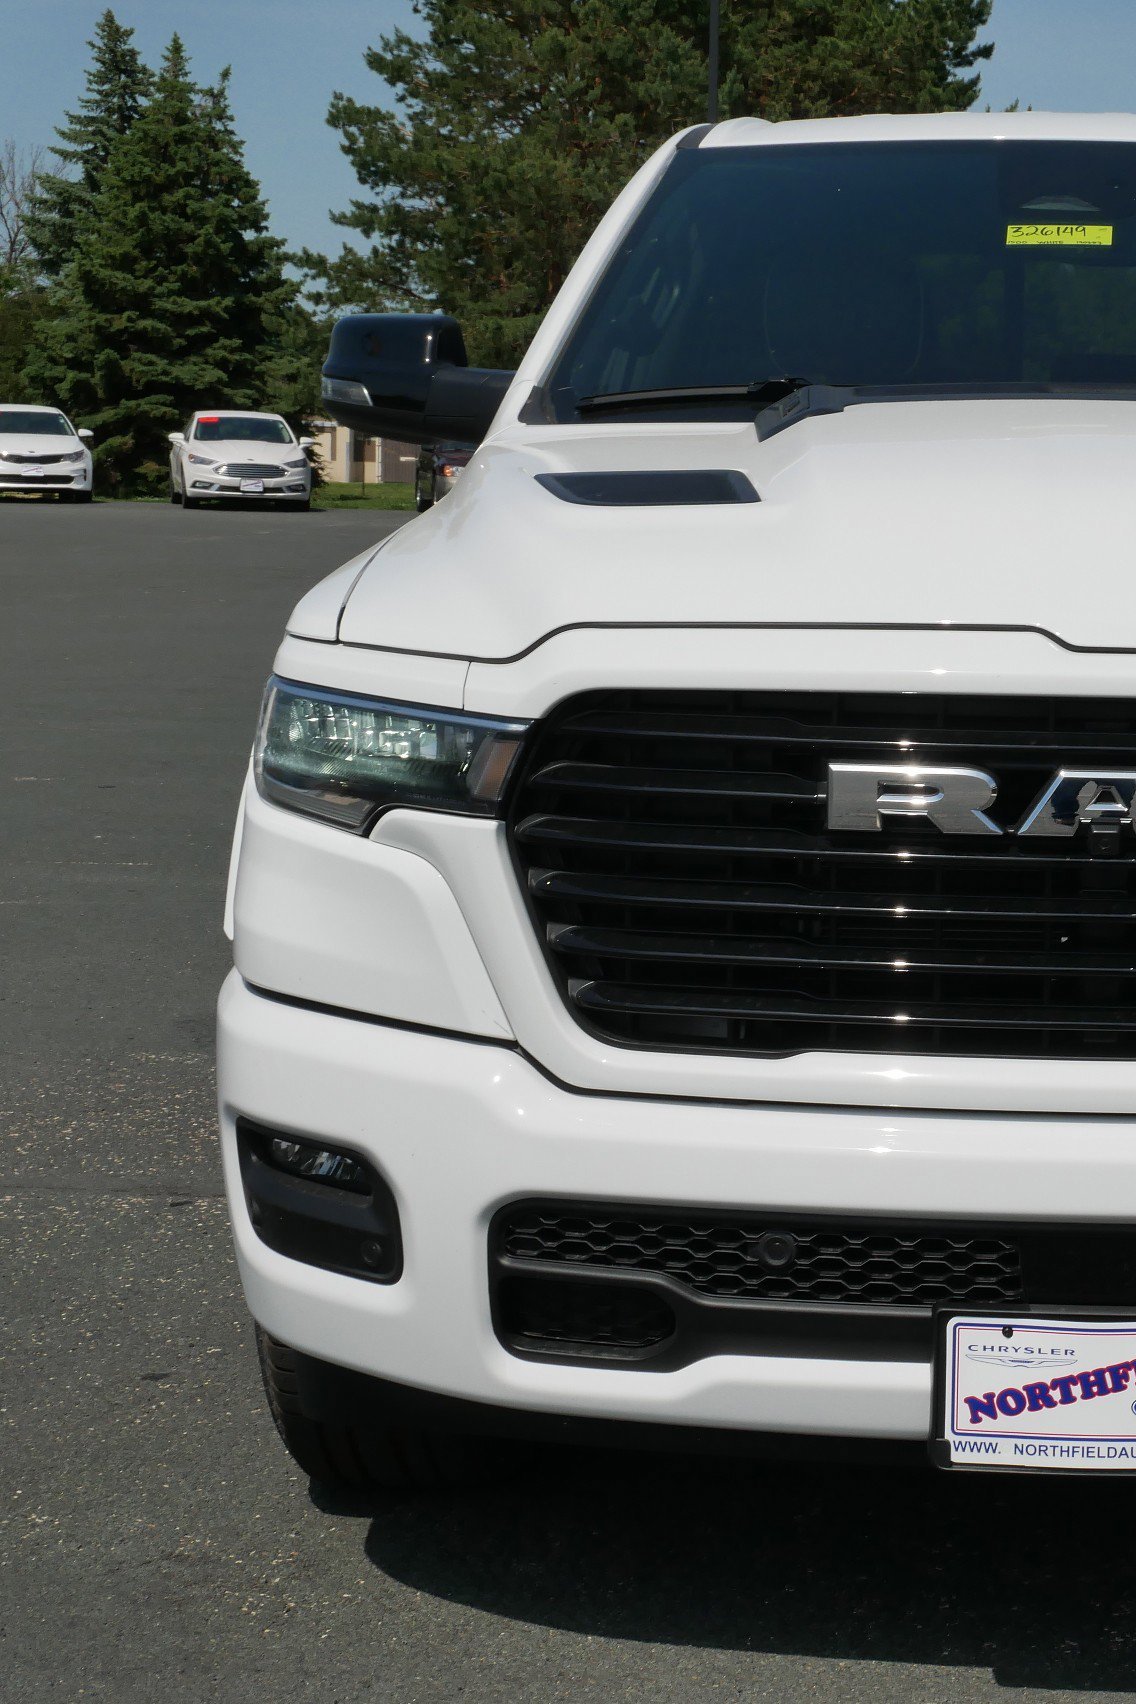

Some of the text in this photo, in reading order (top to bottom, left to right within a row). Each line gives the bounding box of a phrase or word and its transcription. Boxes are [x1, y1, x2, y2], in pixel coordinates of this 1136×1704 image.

[1010, 226, 1086, 237] 326149
[967, 1344, 1076, 1356] CHRYSLER
[953, 1440, 1001, 1454] WWW.
